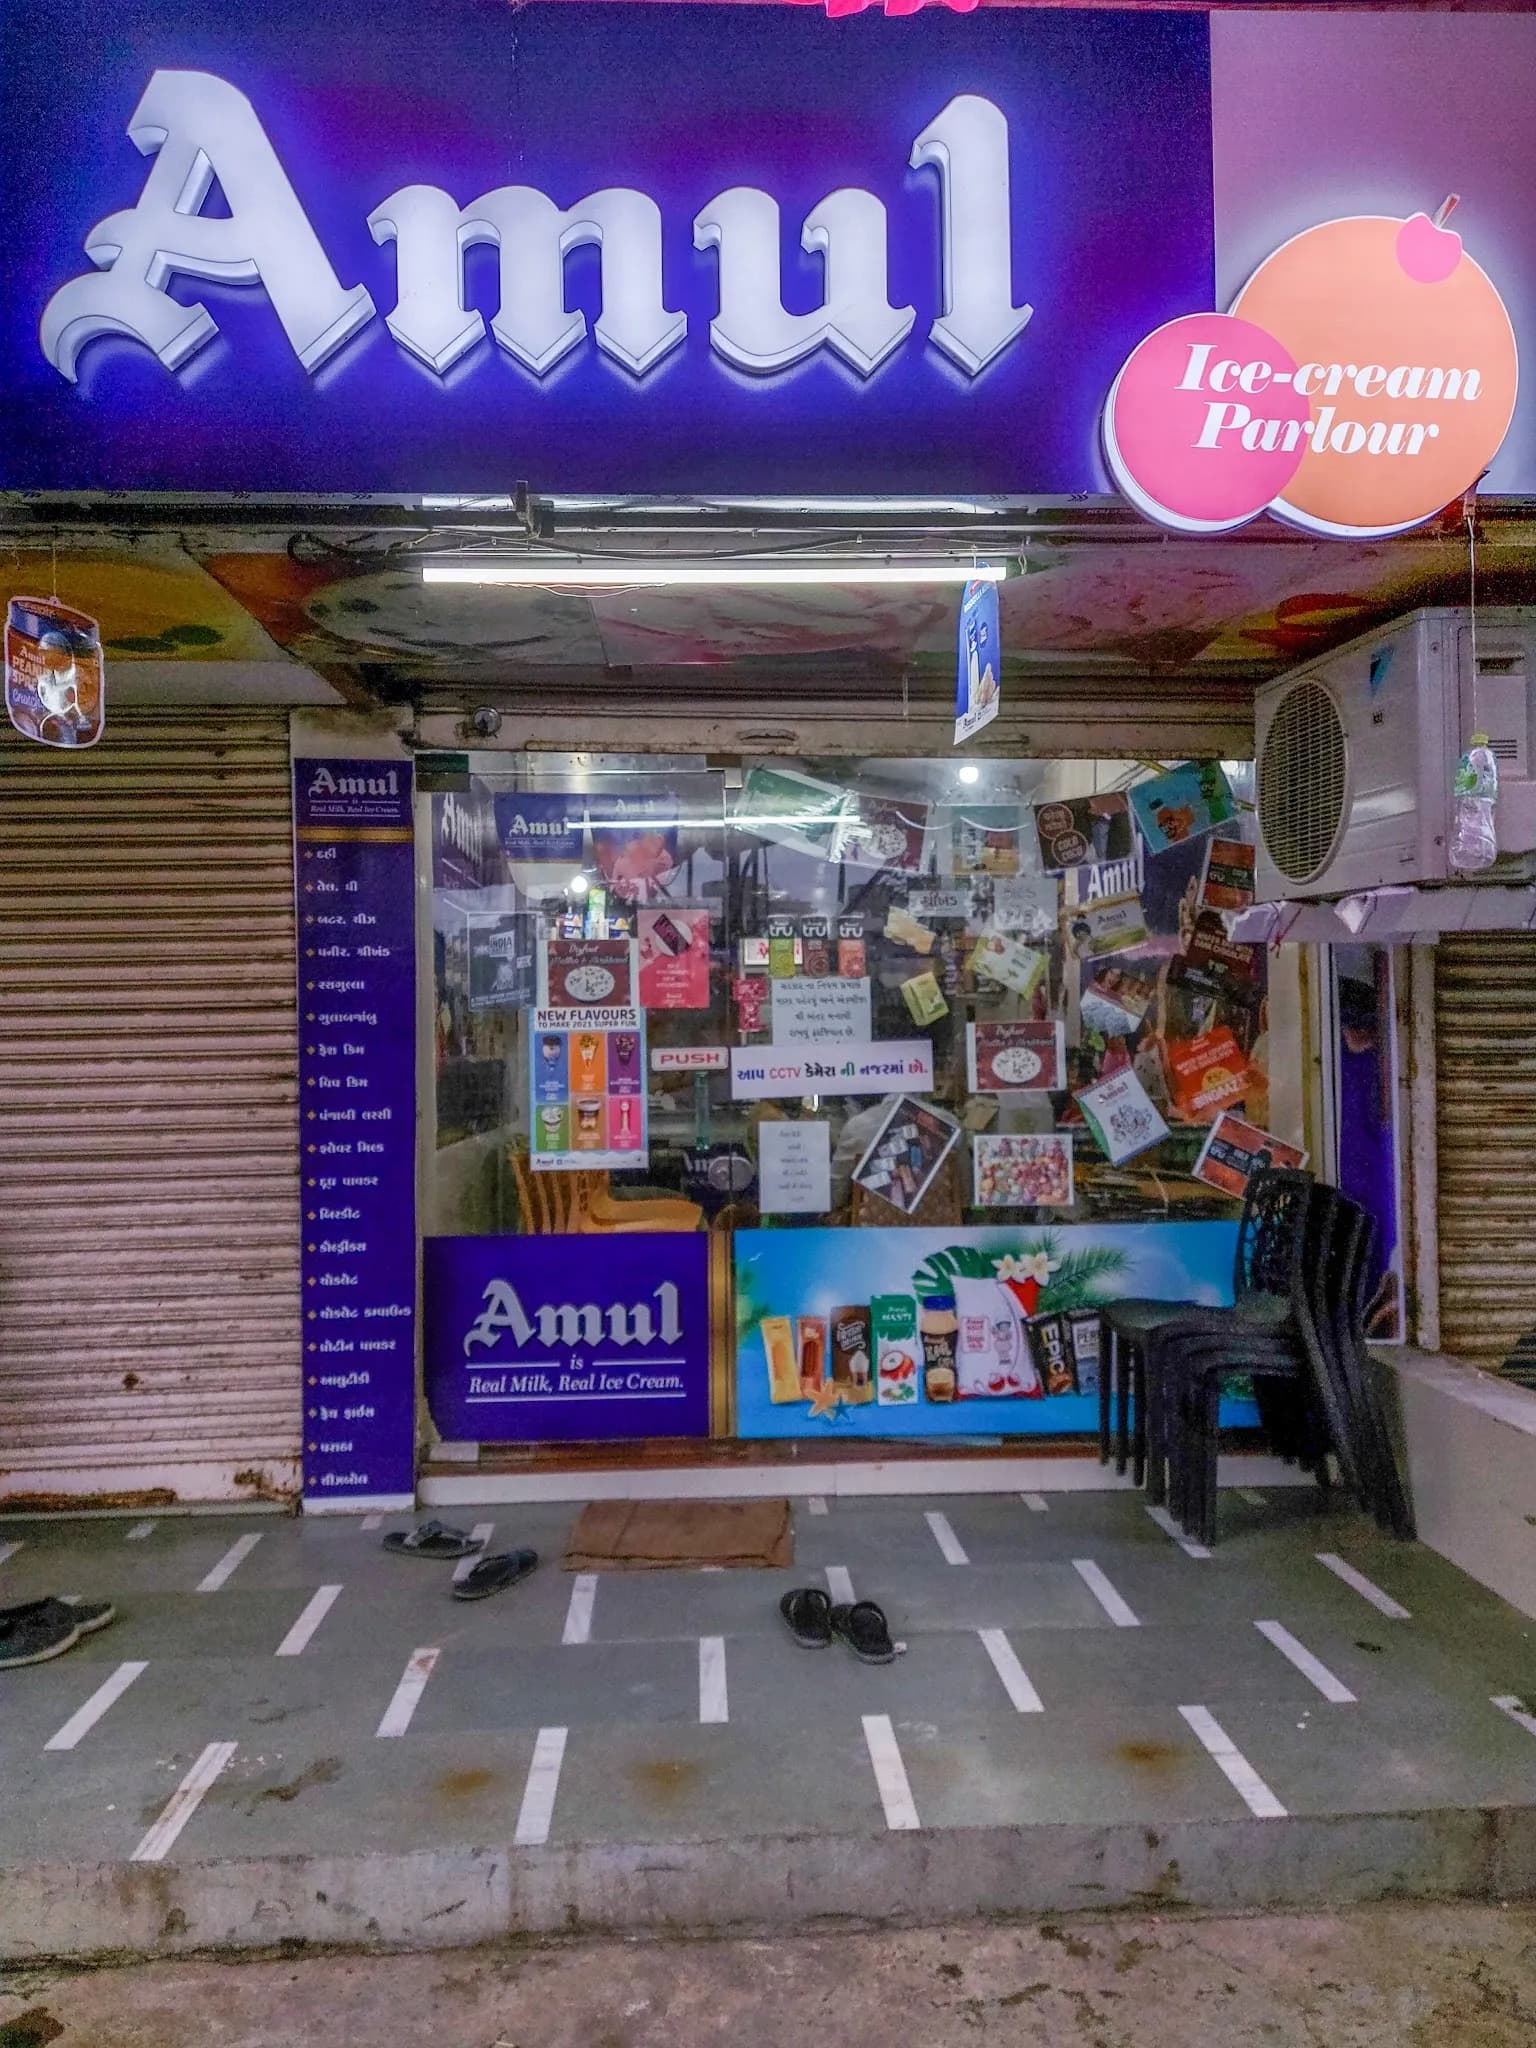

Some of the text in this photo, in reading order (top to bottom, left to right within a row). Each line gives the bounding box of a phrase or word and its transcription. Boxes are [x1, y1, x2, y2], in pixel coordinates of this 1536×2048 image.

[39, 68, 1034, 384] Amul
[1174, 343, 1483, 401] Ice-cream
[1190, 401, 1440, 455] Parlour
[308, 767, 399, 798] Amul
[509, 813, 571, 837] Amul
[537, 1008, 636, 1022] NEW FLAVOURS
[660, 1052, 720, 1064] PUSH
[737, 1068, 765, 1081] આપ
[769, 1066, 801, 1080] CCTV
[805, 1063, 836, 1078] કેમેરા
[840, 1061, 855, 1076] ની
[860, 1059, 904, 1076] નજરમાં
[463, 1278, 685, 1358] Amul
[570, 1354, 585, 1370] is
[469, 1372, 685, 1395] Real Milk, Real Ice Cream.
